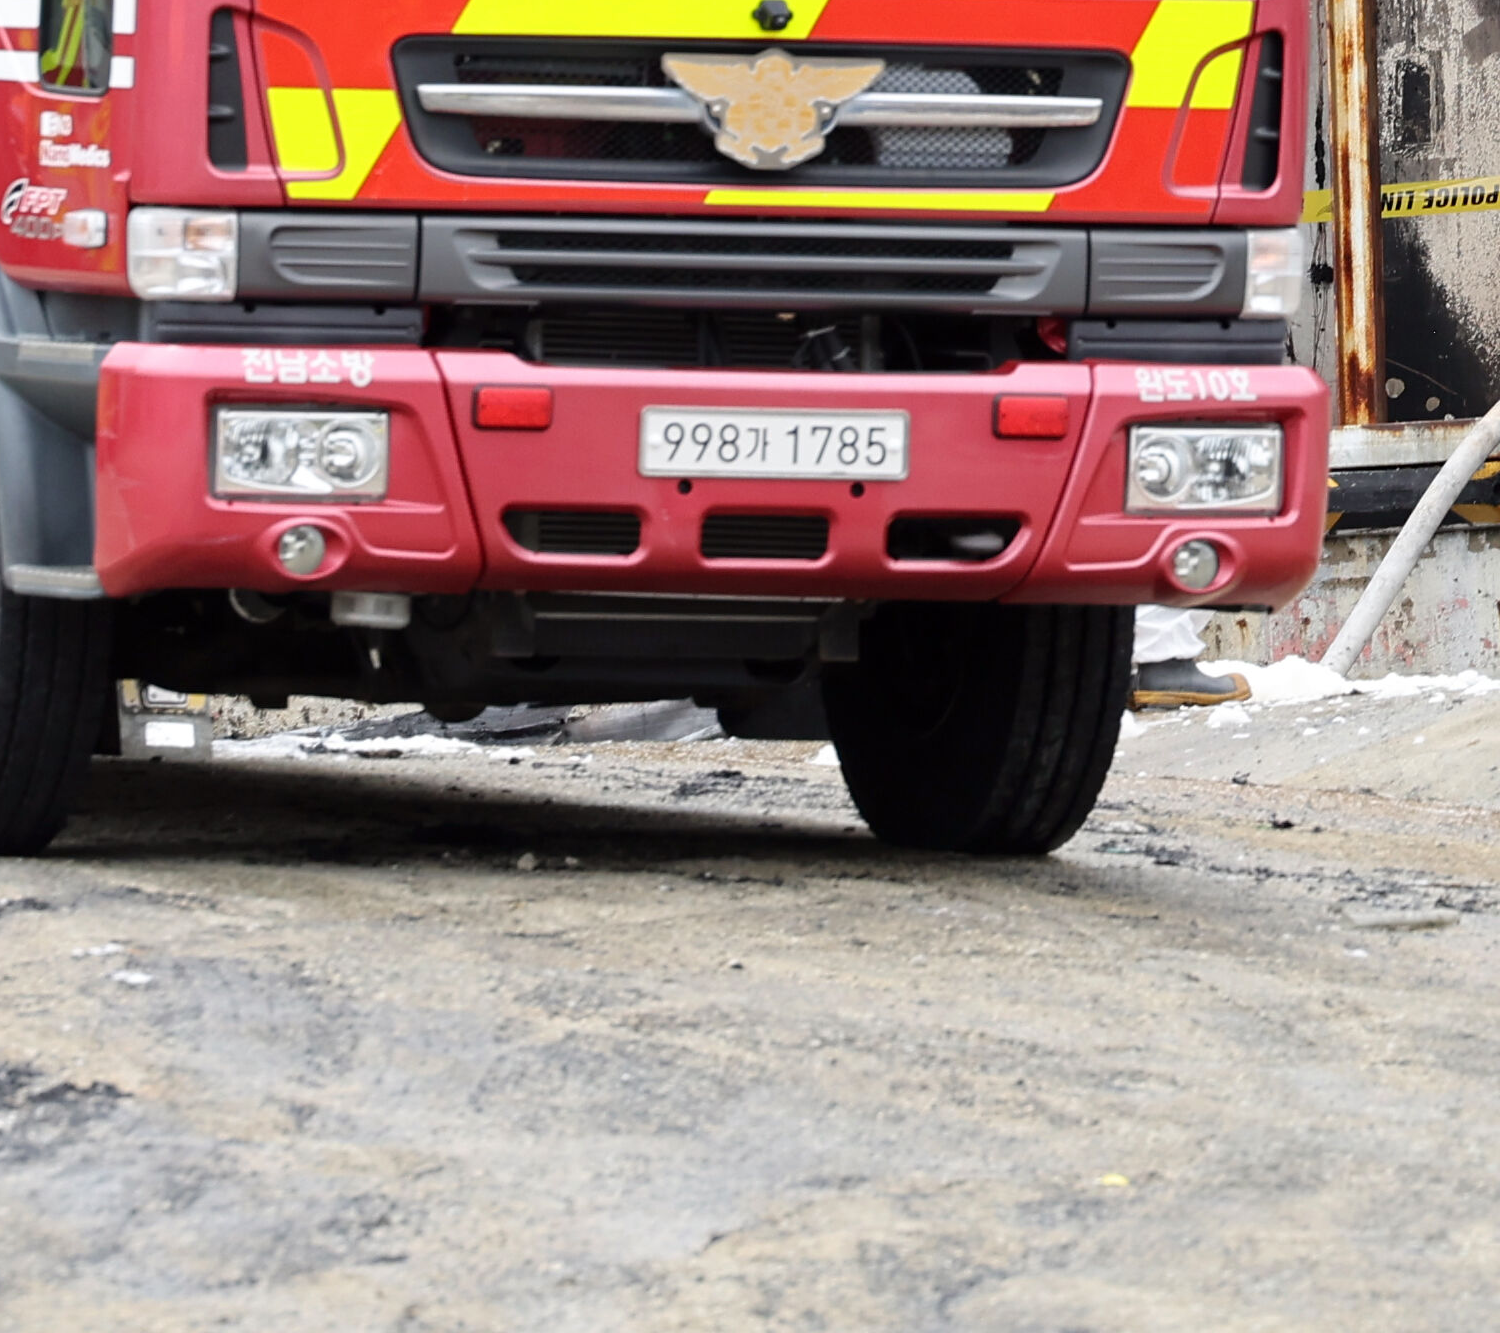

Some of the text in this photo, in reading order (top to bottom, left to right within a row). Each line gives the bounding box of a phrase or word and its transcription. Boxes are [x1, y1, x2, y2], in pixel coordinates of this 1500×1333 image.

[19, 186, 68, 215] FPT
[1381, 192, 1415, 212] LIN
[1422, 184, 1499, 209] POLICE
[242, 347, 375, 388] 전남소방
[1134, 366, 1258, 402] 완도10호
[663, 422, 887, 466] 998가 1785
